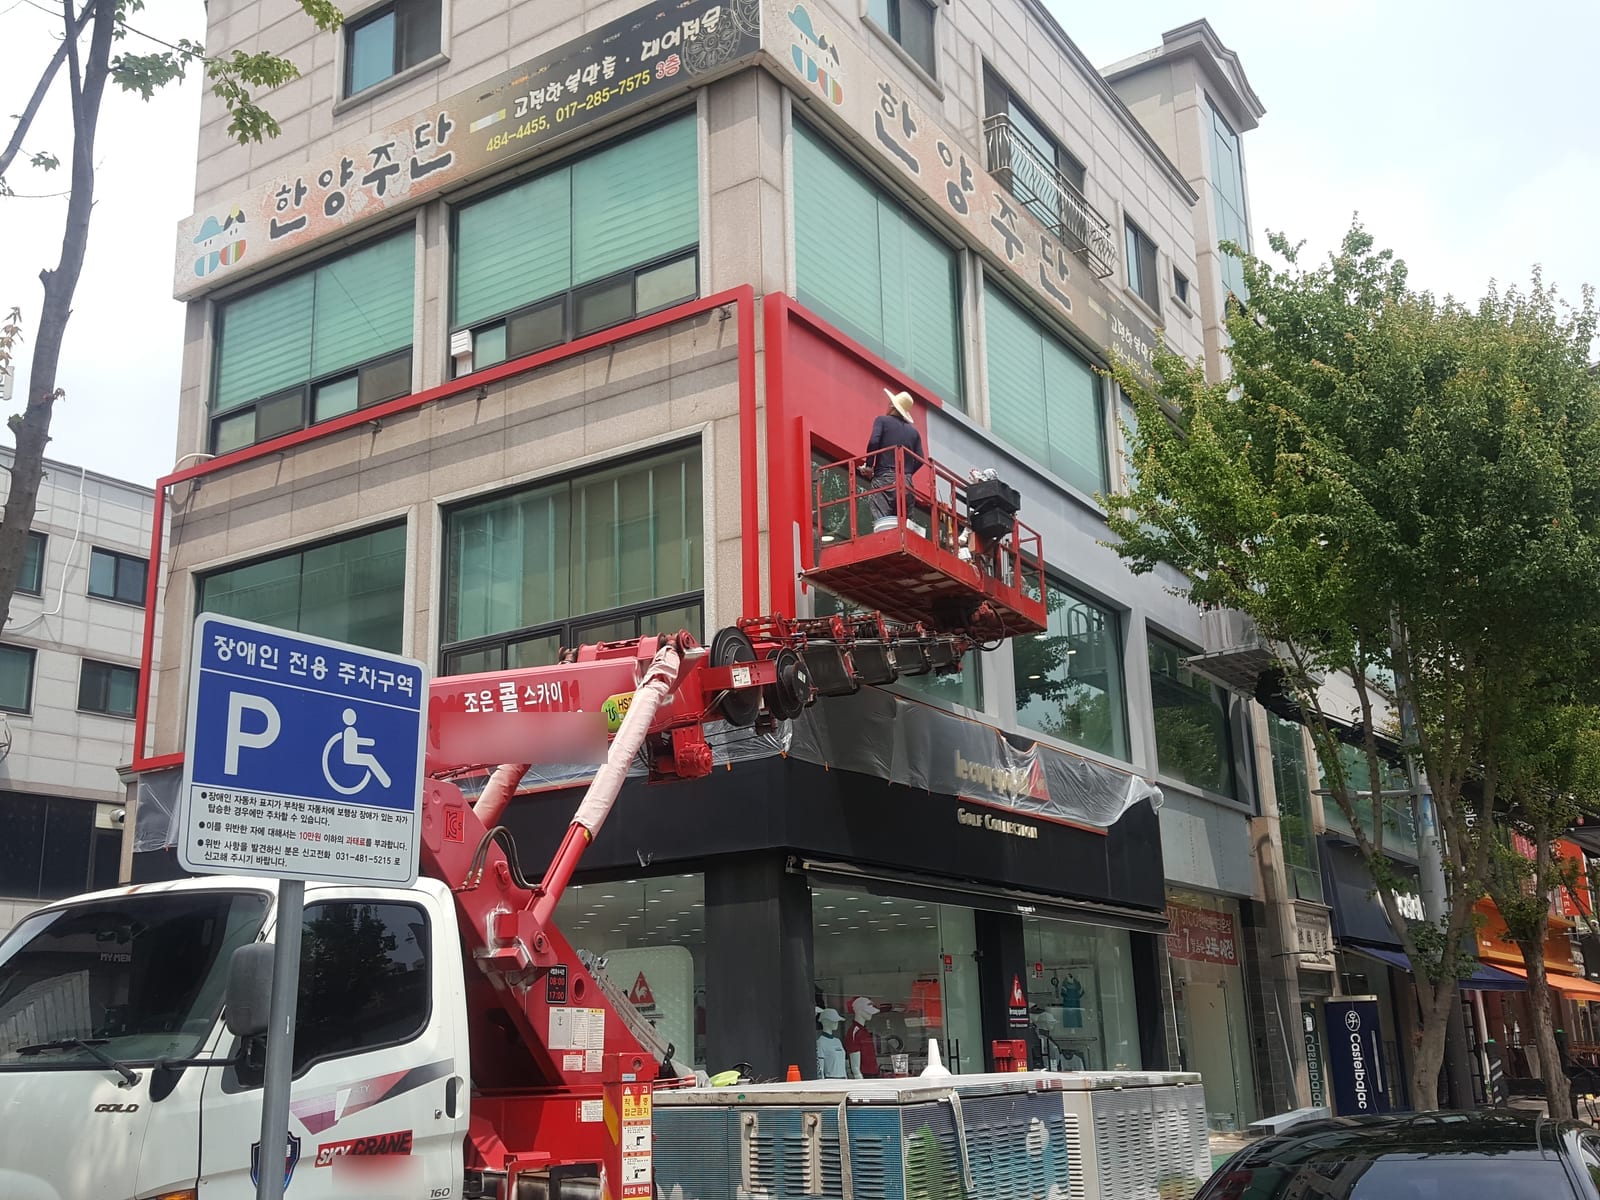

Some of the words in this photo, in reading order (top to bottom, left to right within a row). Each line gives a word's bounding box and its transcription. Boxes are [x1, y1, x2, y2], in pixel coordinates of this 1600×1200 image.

[655, 53, 681, 80] 3층
[486, 115, 550, 152] 484-4455,
[555, 69, 651, 123] 017-285-7575
[268, 110, 457, 241] 한양주단
[873, 80, 1073, 313] 한양주단
[214, 635, 279, 670] 장애인
[289, 651, 328, 680] 전용
[338, 662, 414, 697] 주차구역
[464, 689, 494, 712] 조은
[499, 682, 519, 712] 콜
[524, 681, 563, 706] 스카이
[617, 697, 632, 711] HS
[224, 691, 281, 776] P
[208, 791, 231, 803] 장애인
[234, 795, 257, 807] 자동차
[259, 798, 281, 809] 표지가
[284, 801, 305, 812] 부착된
[307, 804, 335, 816] 자동차에
[337, 807, 358, 819] 보행상
[359, 810, 379, 821] 장애가
[381, 812, 394, 823] 있는
[395, 815, 408, 825] 자가
[208, 803, 231, 815] 탑승한
[234, 806, 264, 819] 경우에만
[266, 810, 288, 821] 주차할
[290, 813, 298, 823] 수
[300, 814, 330, 826] 있습니다.
[206, 821, 221, 832] 이를
[224, 823, 248, 834] 위반한
[250, 826, 265, 836] 자에
[268, 828, 296, 840] 대해서는
[299, 831, 321, 842] 10만원
[323, 834, 344, 844] 이하의
[345, 836, 372, 847] 과태료를
[374, 839, 408, 851] 부과합니다.
[204, 851, 228, 862] 신고해
[230, 853, 253, 864] 주시기
[255, 855, 287, 868] 바랍니다.
[205, 838, 221, 849] 위반
[224, 840, 248, 852] 사항을
[251, 843, 281, 854] 발견하신
[284, 846, 300, 857] 분은
[302, 848, 331, 859] 신고전화
[335, 852, 391, 865] 031-481-5215
[394, 857, 401, 866] 로
[94, 1103, 139, 1113] GOLD
[352, 1132, 412, 1155] CRANE
[430, 1187, 450, 1198] 160
